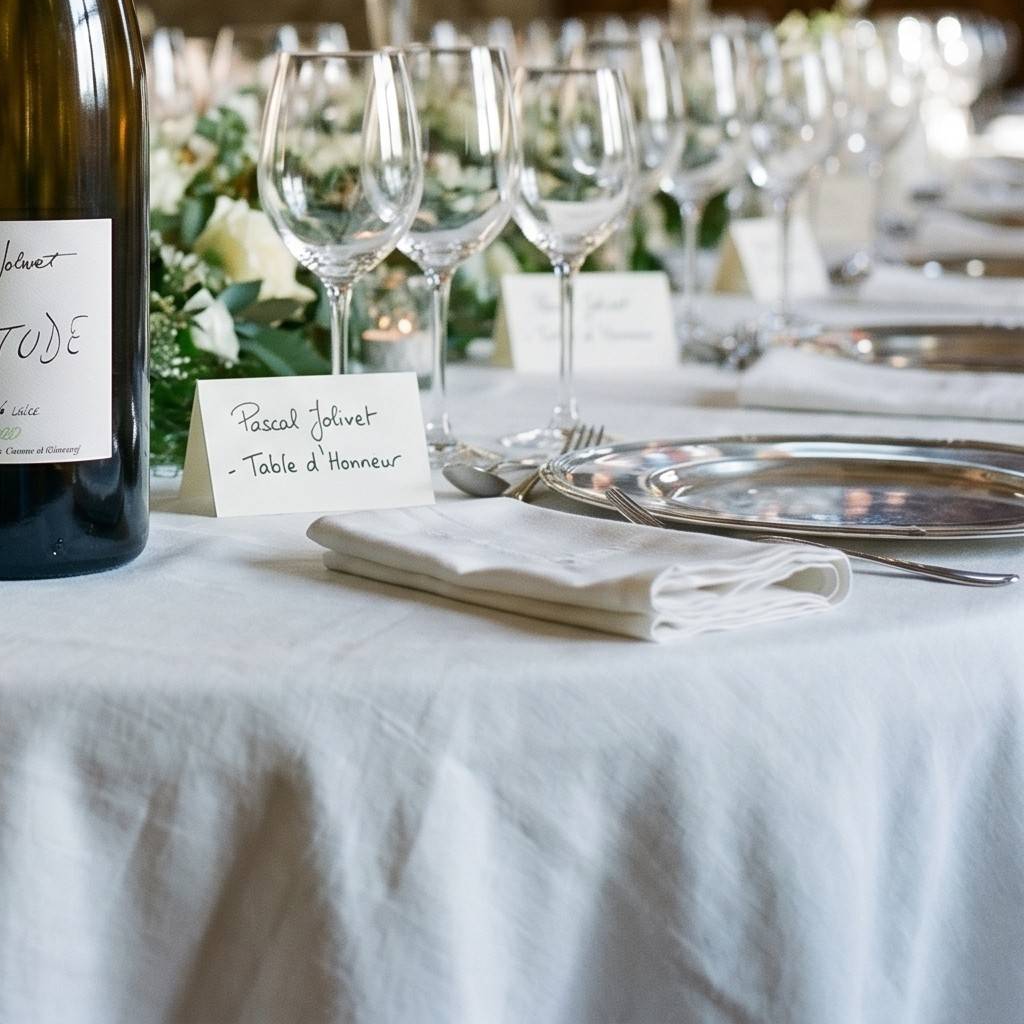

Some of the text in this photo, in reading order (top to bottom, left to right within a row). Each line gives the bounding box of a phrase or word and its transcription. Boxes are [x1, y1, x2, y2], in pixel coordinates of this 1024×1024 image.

[230, 399, 378, 442] Pascal Jolivet
[242, 451, 298, 477] Table
[306, 444, 403, 473] d'Honneur
